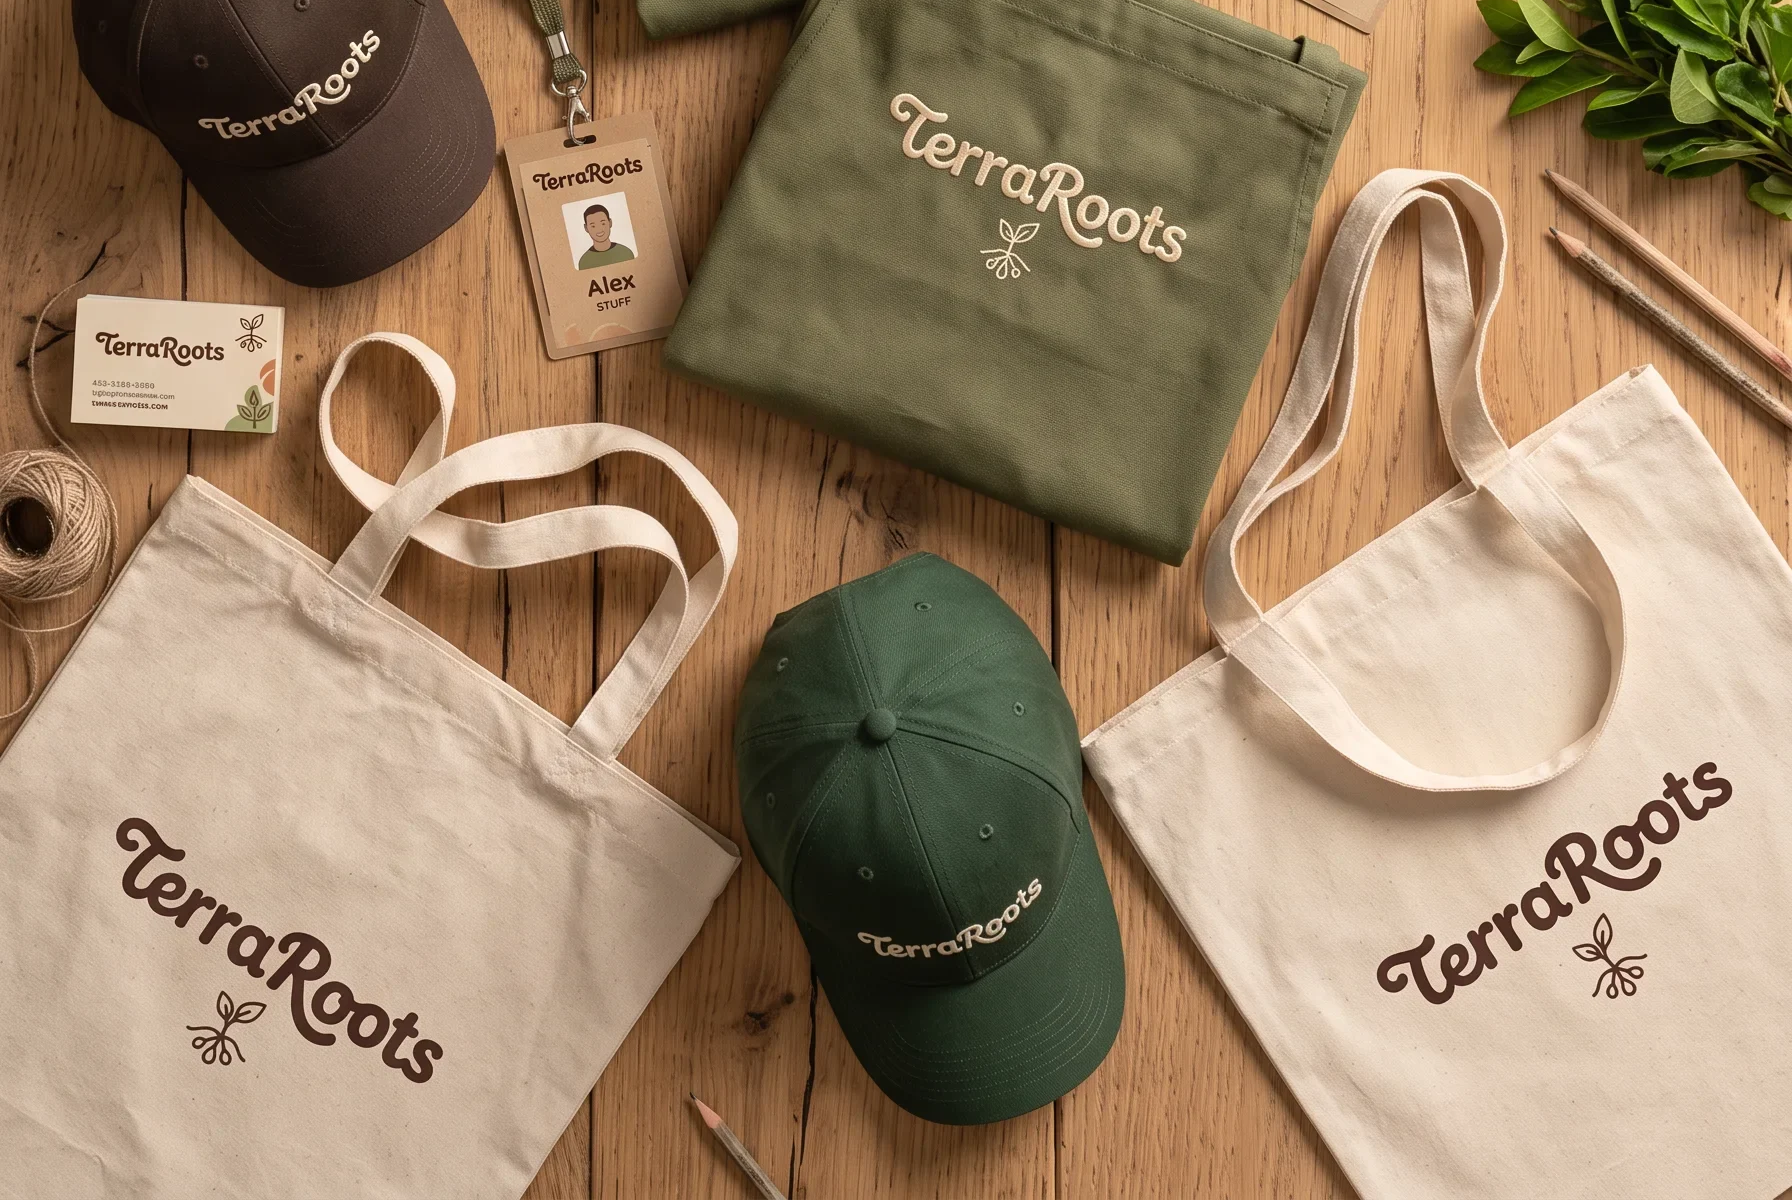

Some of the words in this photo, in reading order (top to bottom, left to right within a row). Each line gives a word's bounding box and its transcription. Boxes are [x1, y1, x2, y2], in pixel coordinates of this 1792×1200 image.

[199, 29, 381, 141] TerraRoots
[533, 157, 643, 191] TerraRoots
[890, 91, 1188, 265] TerraRoots
[588, 275, 636, 297] Alex
[597, 297, 631, 311] STUFF
[95, 332, 225, 366] TerraRoots
[857, 877, 1044, 961] TerraRoots
[1377, 761, 1733, 1005] TerraRoots
[116, 817, 444, 1084] TerraRoots
